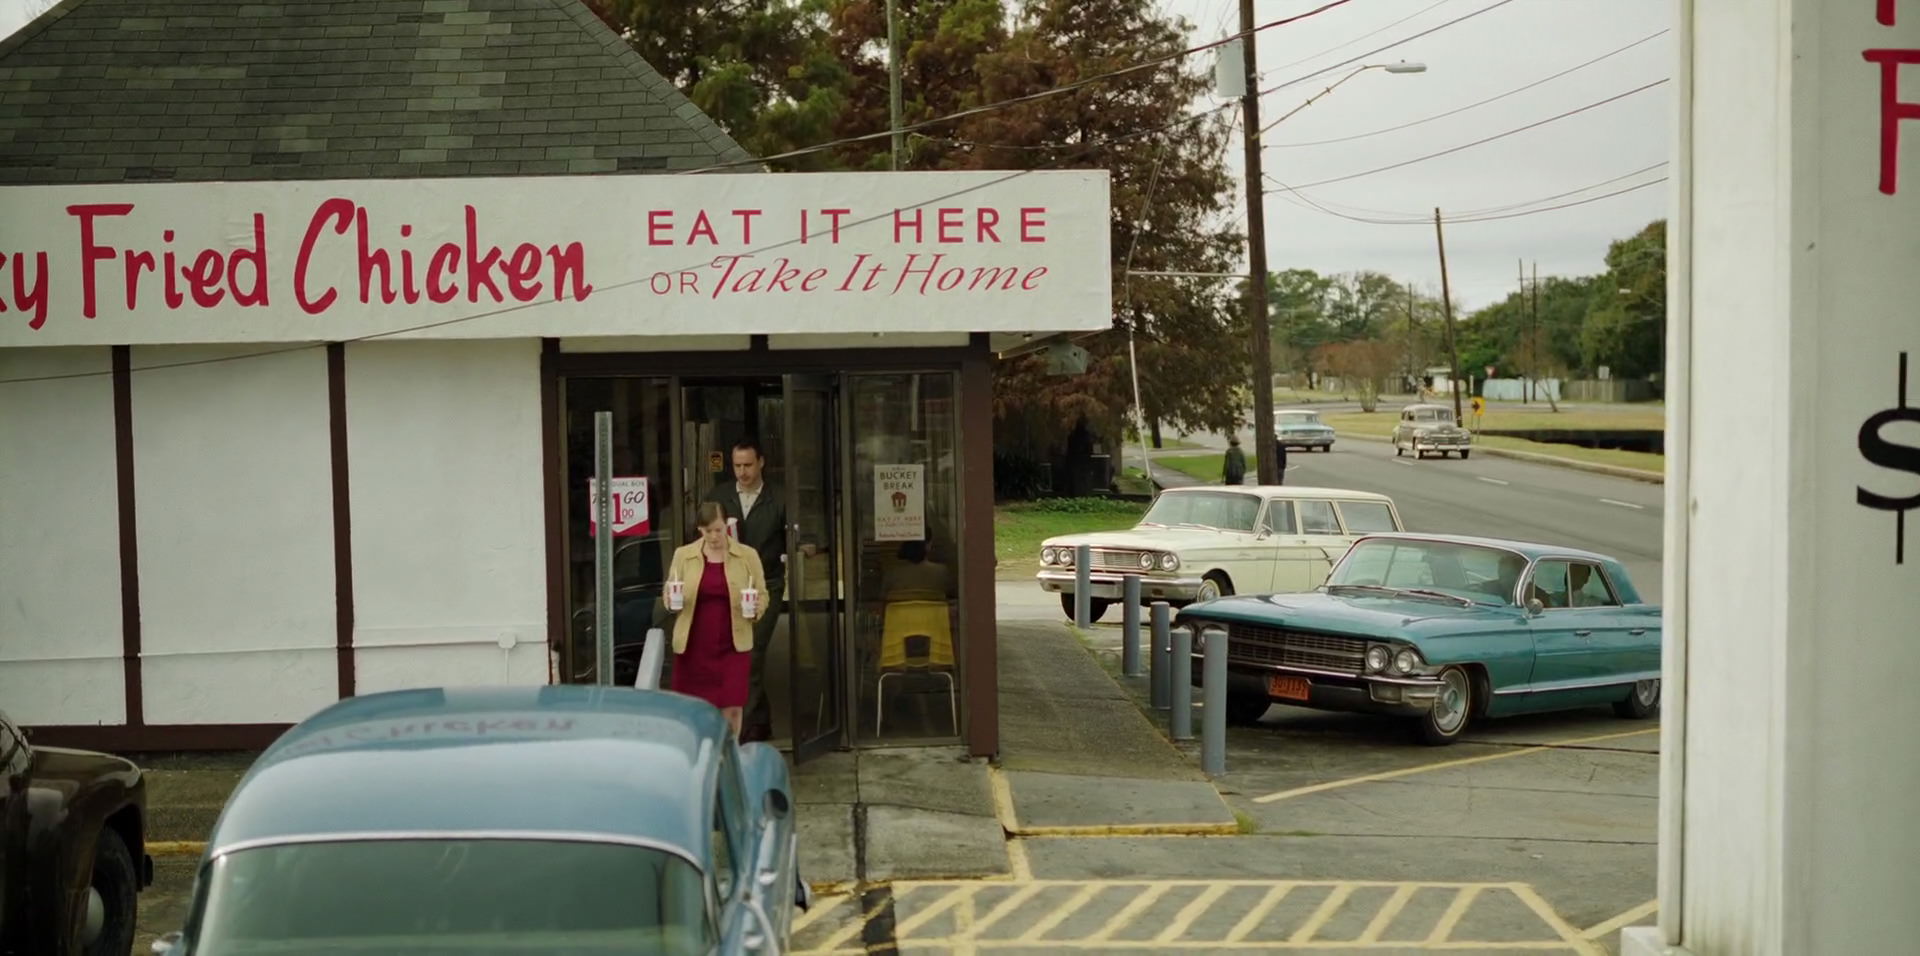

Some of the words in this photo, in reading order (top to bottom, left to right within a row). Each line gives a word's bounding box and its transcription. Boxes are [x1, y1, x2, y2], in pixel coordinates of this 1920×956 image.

[648, 210, 762, 246] EAT
[801, 208, 851, 244] IT
[893, 207, 1047, 244] HERE
[67, 204, 269, 319] Fried
[294, 197, 593, 315] Chicken
[651, 271, 700, 295] OR
[711, 255, 829, 300] Take
[834, 254, 888, 292] It
[890, 253, 1048, 296] Home
[880, 471, 917, 480] BUCKET
[884, 481, 914, 490] BREAK
[624, 490, 645, 504] GO
